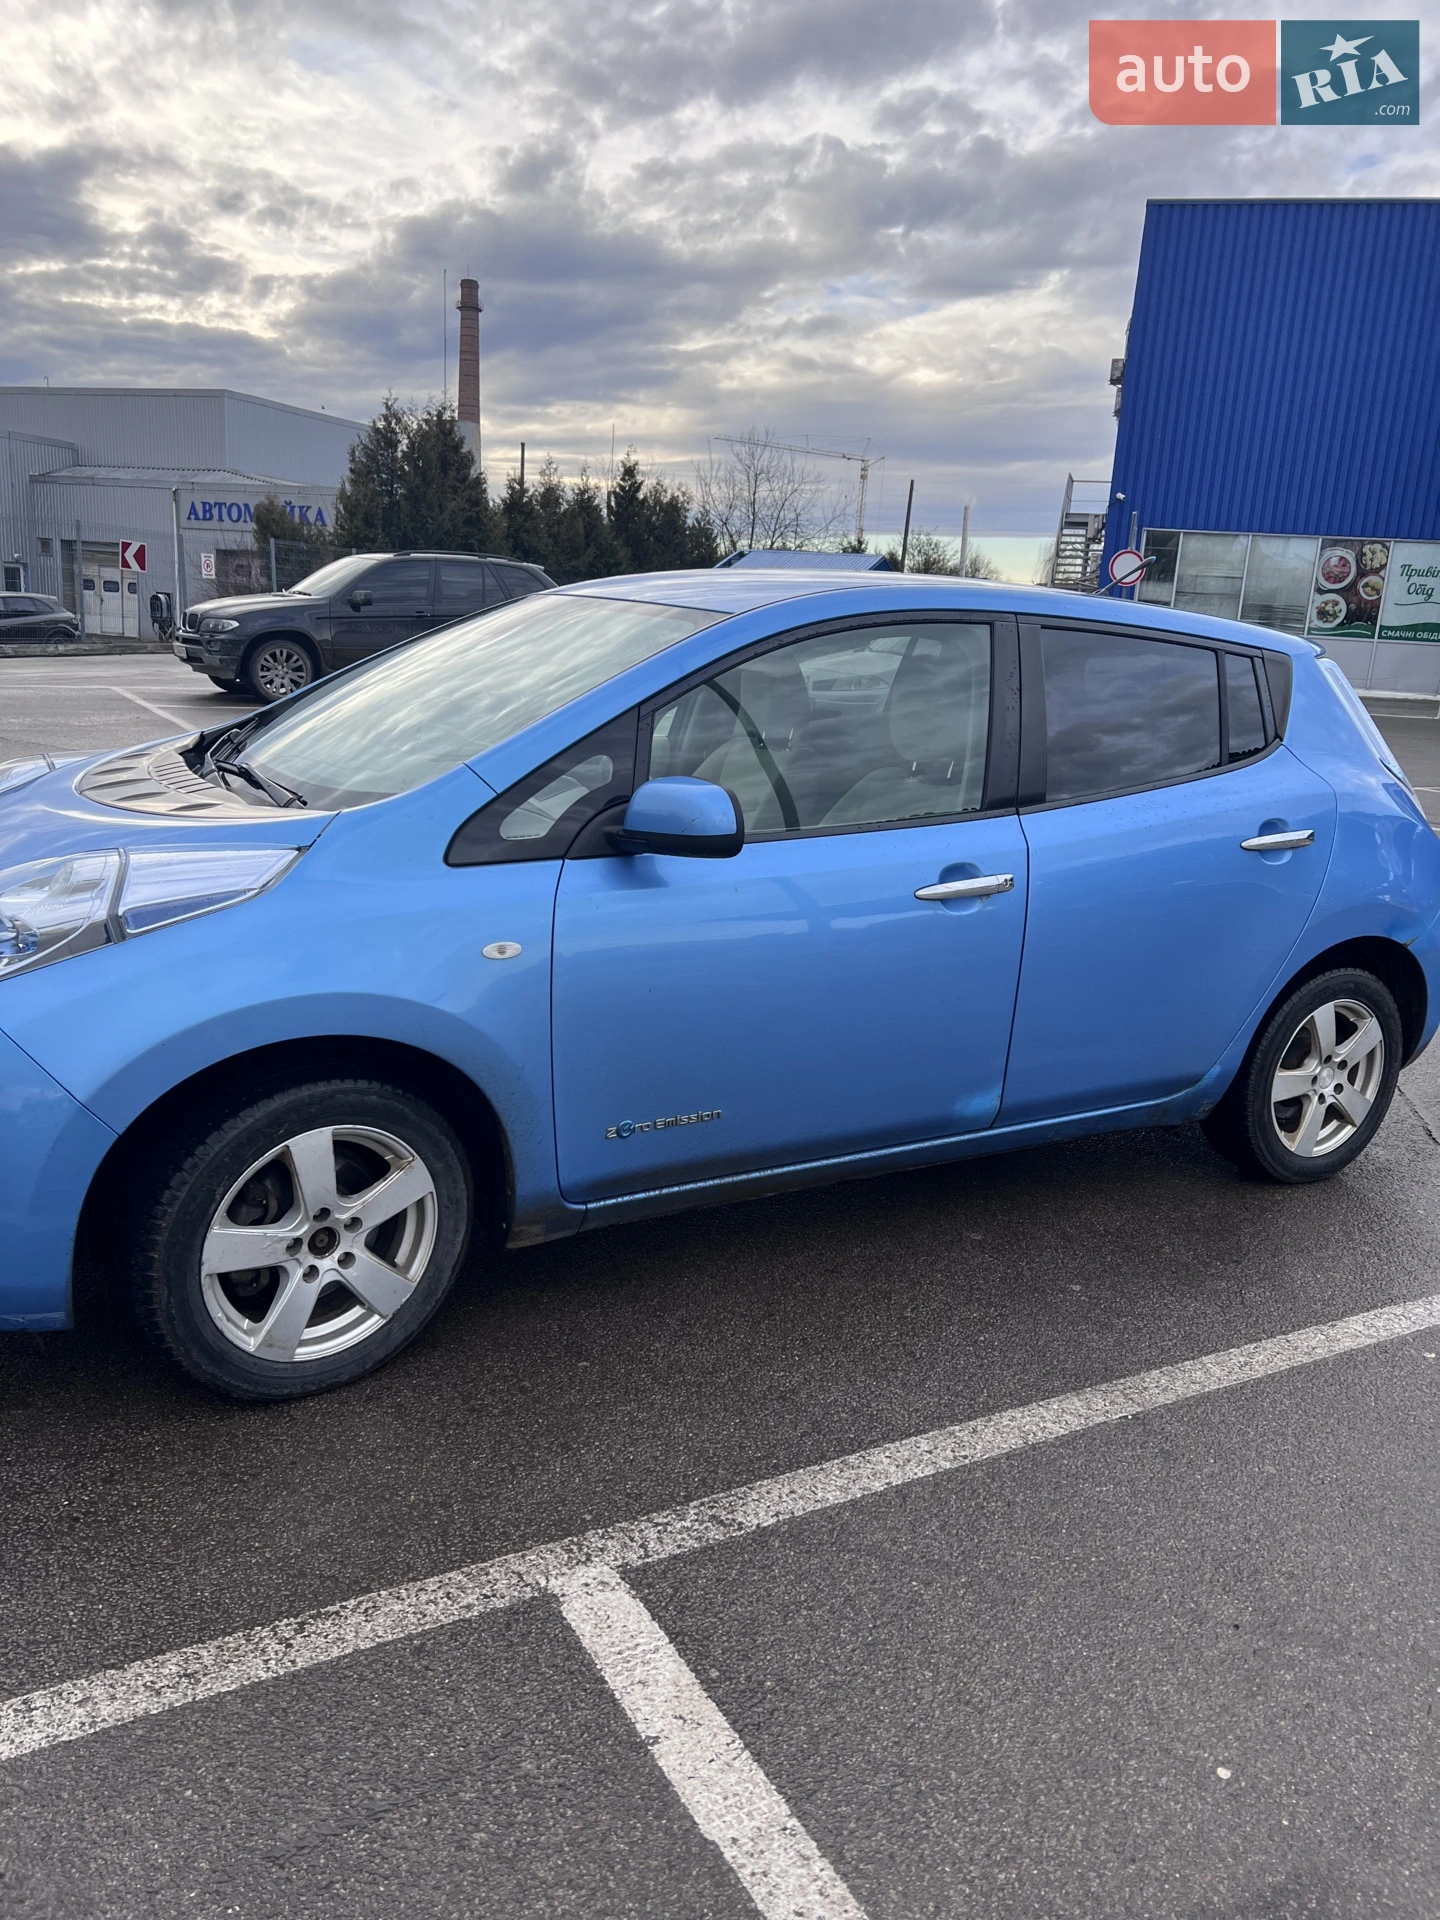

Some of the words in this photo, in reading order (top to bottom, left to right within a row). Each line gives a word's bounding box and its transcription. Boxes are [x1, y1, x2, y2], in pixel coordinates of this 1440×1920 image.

[187, 500, 327, 527] АВТОМЙКА
[1407, 582, 1435, 602] Обід
[1381, 629, 1415, 639] СМАЧНІ
[654, 1109, 722, 1130] Emission
